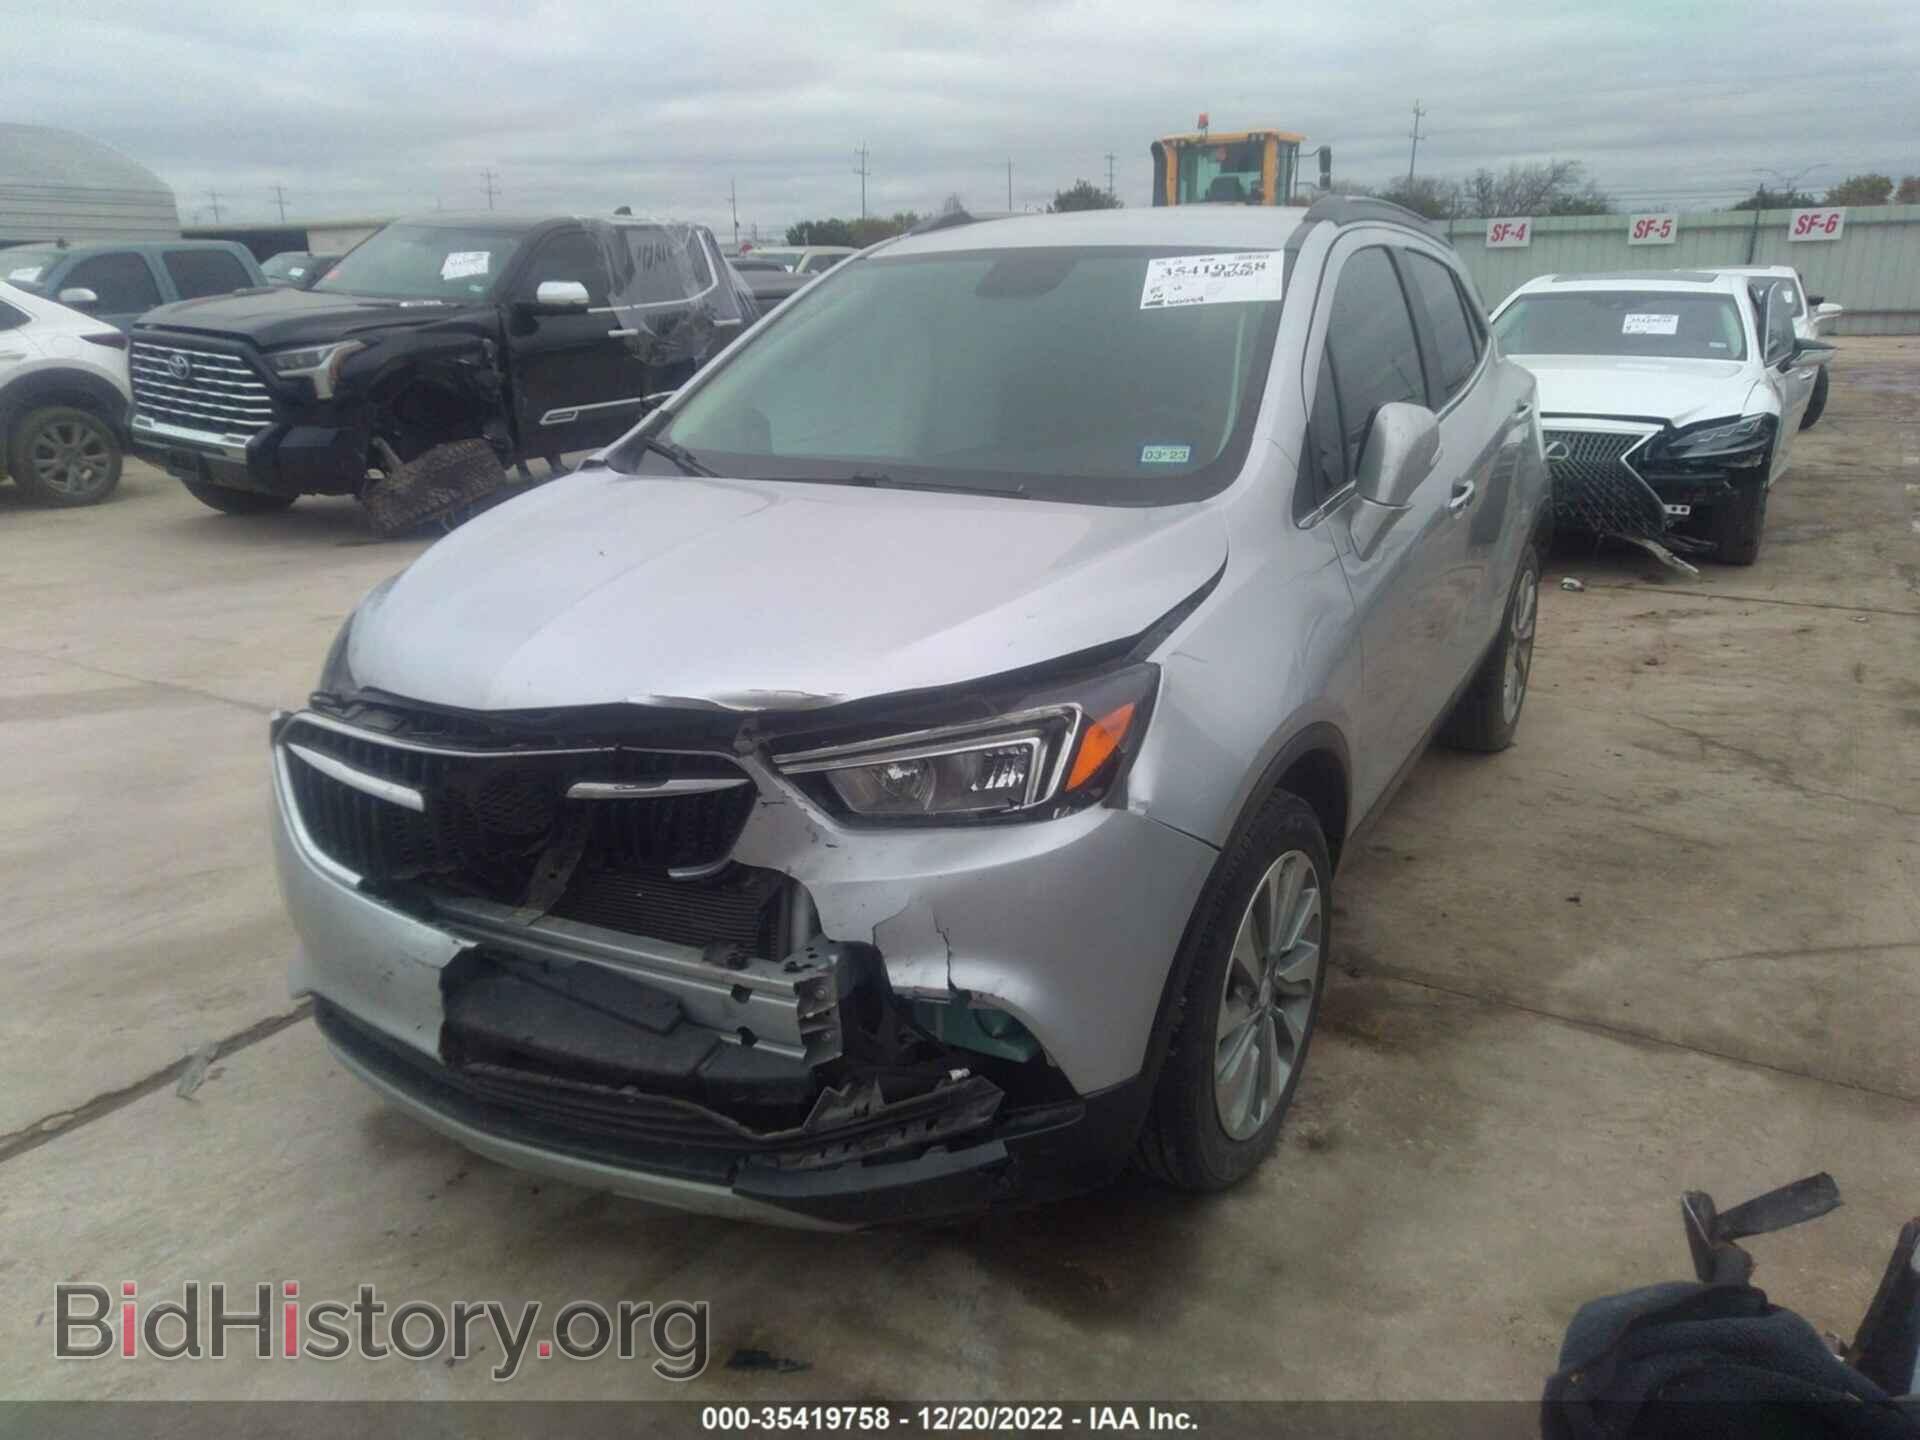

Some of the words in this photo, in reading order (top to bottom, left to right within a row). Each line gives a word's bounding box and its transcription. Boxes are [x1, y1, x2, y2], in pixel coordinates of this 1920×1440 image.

[1490, 223, 1527, 242] SF-4
[1633, 219, 1673, 239] SF-5
[1794, 213, 1840, 235] SF-6
